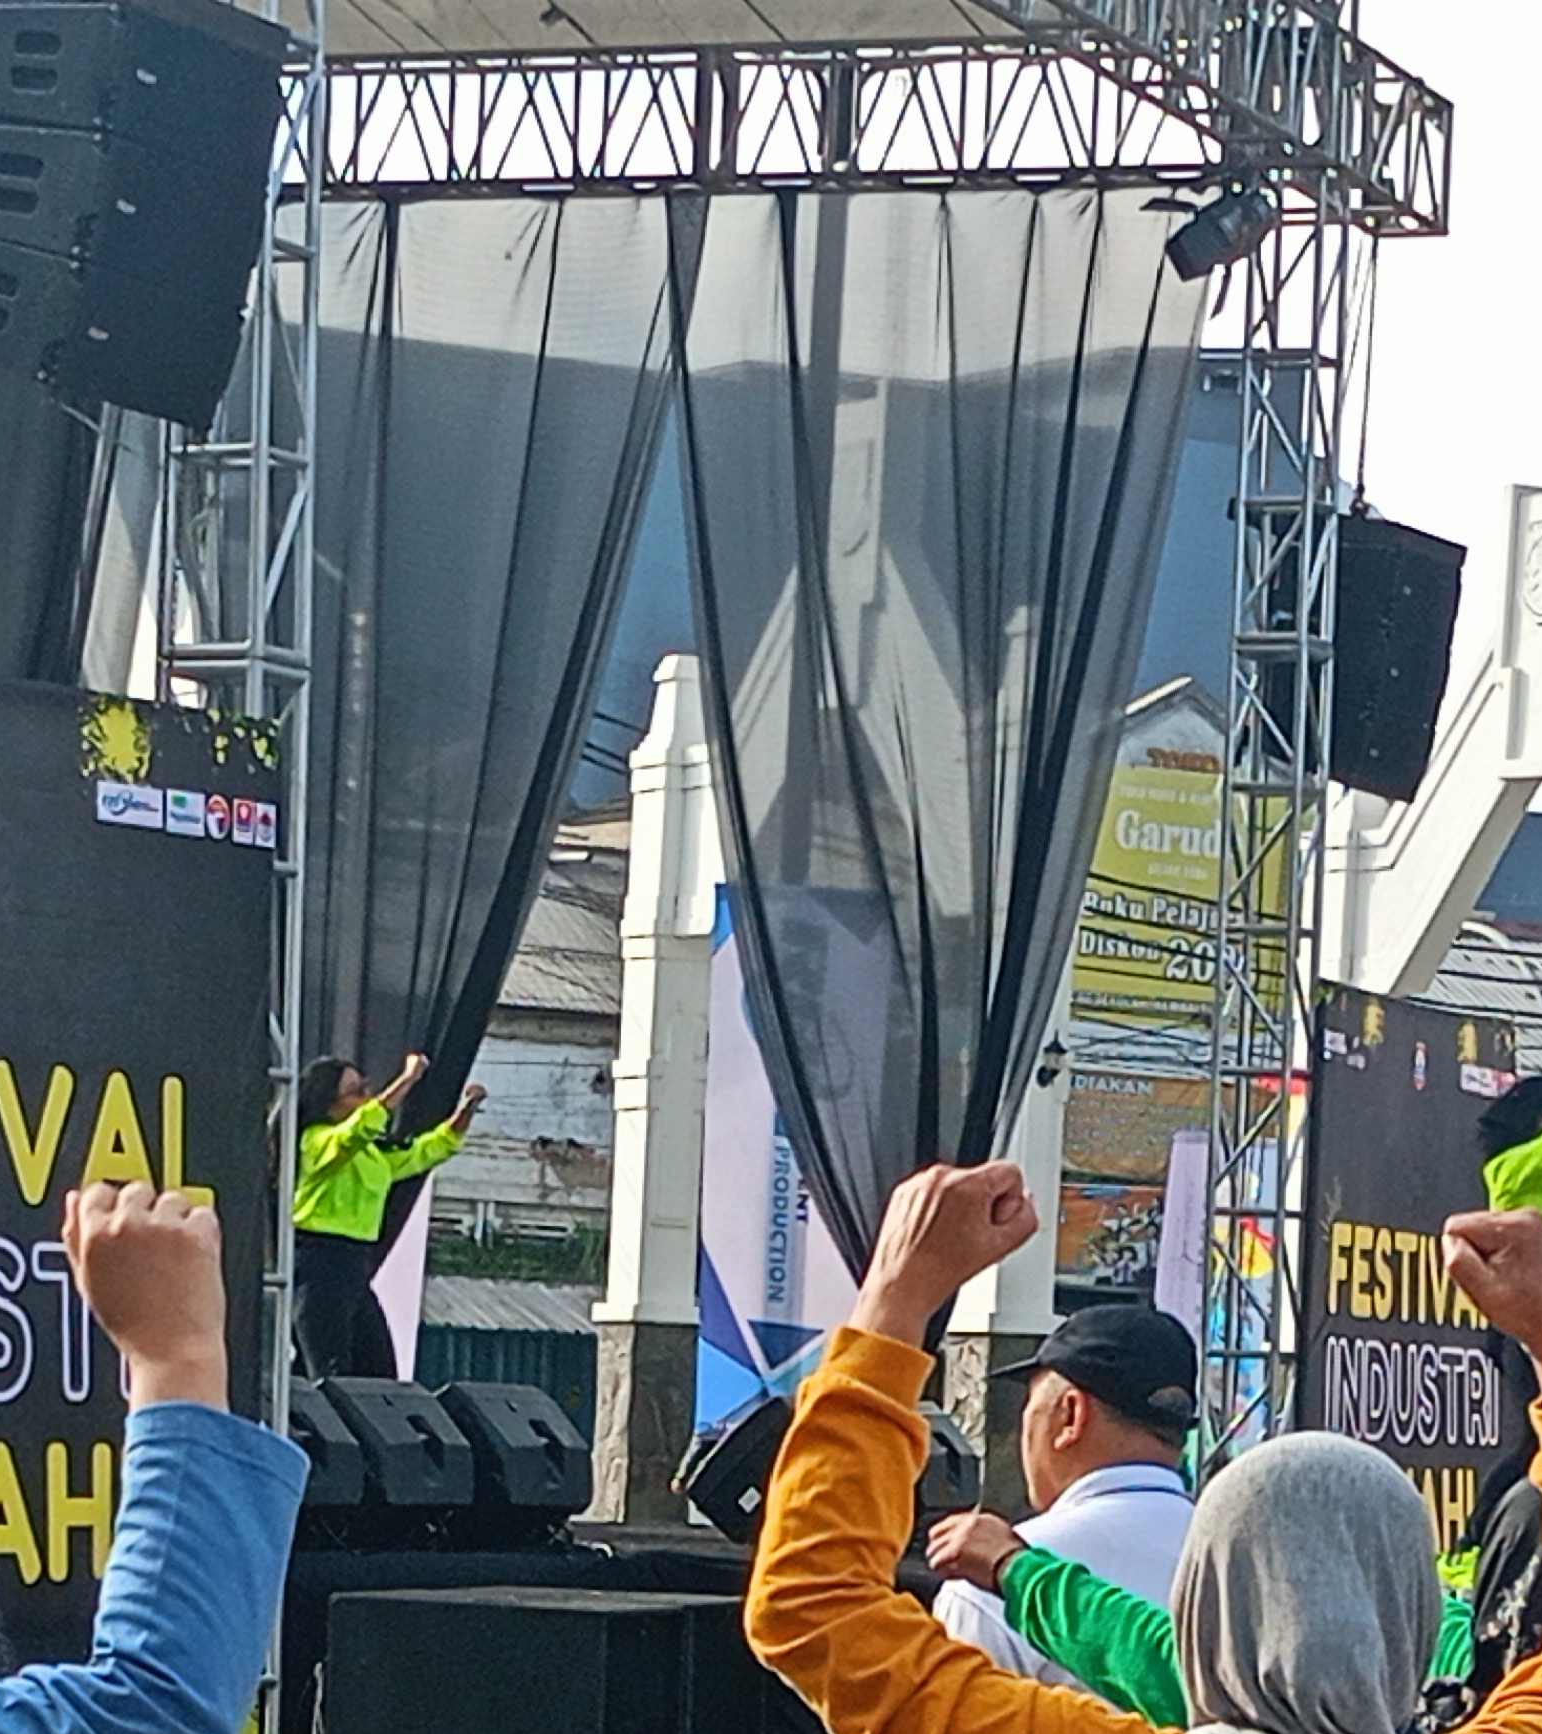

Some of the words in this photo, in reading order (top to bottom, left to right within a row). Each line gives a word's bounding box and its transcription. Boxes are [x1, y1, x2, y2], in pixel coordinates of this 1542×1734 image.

[1115, 809, 1222, 859] Garud
[1068, 1074, 1154, 1095] DIAKAN
[767, 1145, 791, 1303] PRODUCTION
[1324, 1336, 1500, 1448] INDUSTRI
